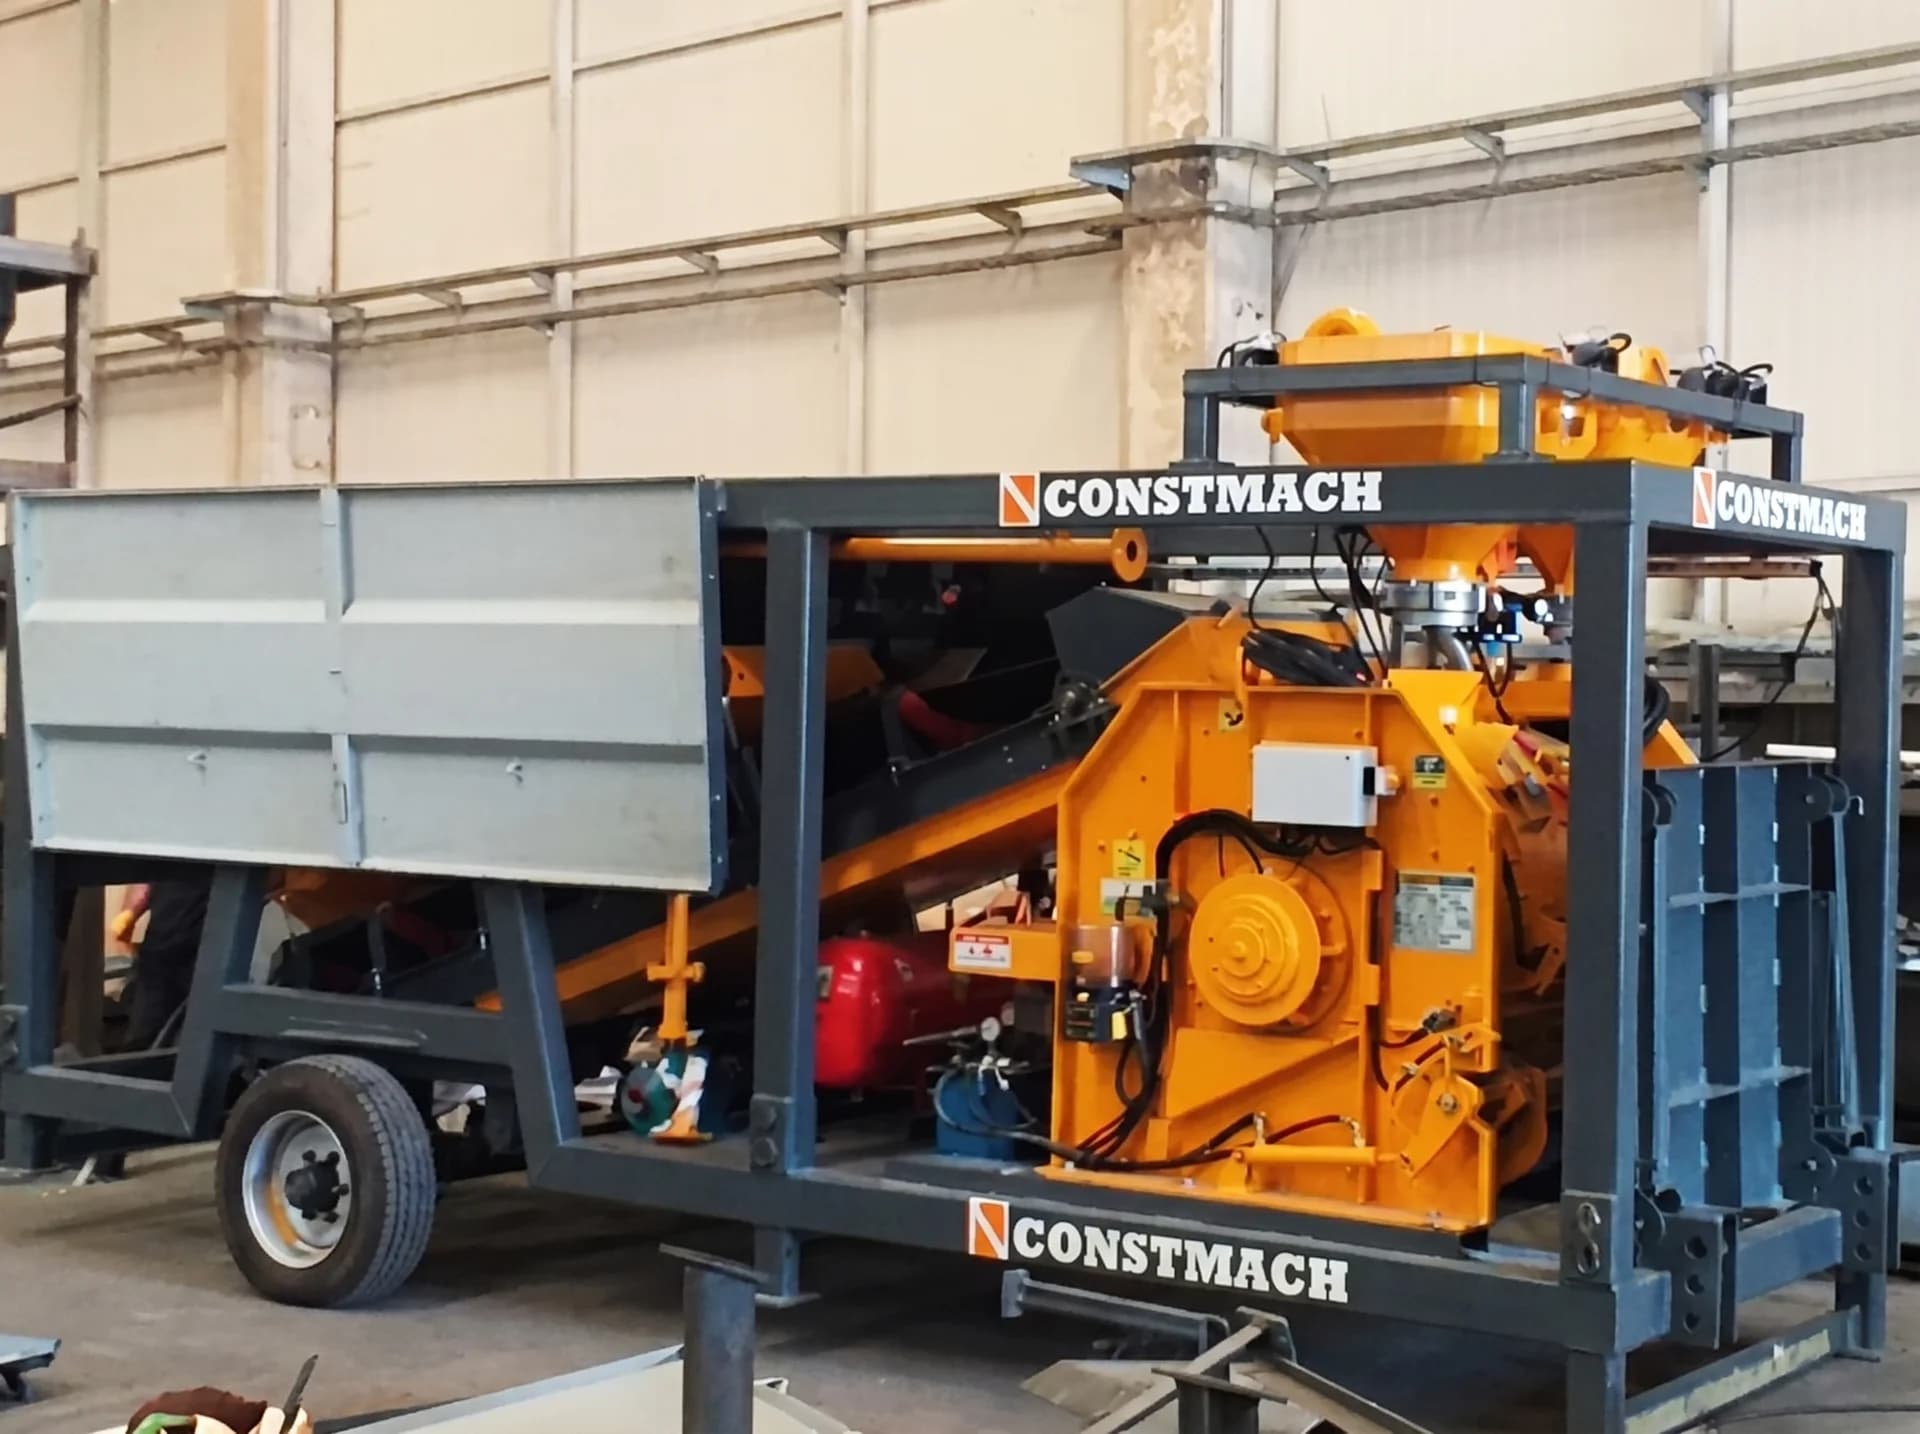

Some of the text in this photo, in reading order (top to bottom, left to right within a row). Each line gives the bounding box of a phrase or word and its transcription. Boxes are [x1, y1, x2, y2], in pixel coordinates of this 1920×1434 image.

[1043, 472, 1383, 518] CONSTMACH
[1717, 481, 1866, 541] CONSTMACH
[1013, 1218, 1349, 1303] CONSTMACH
